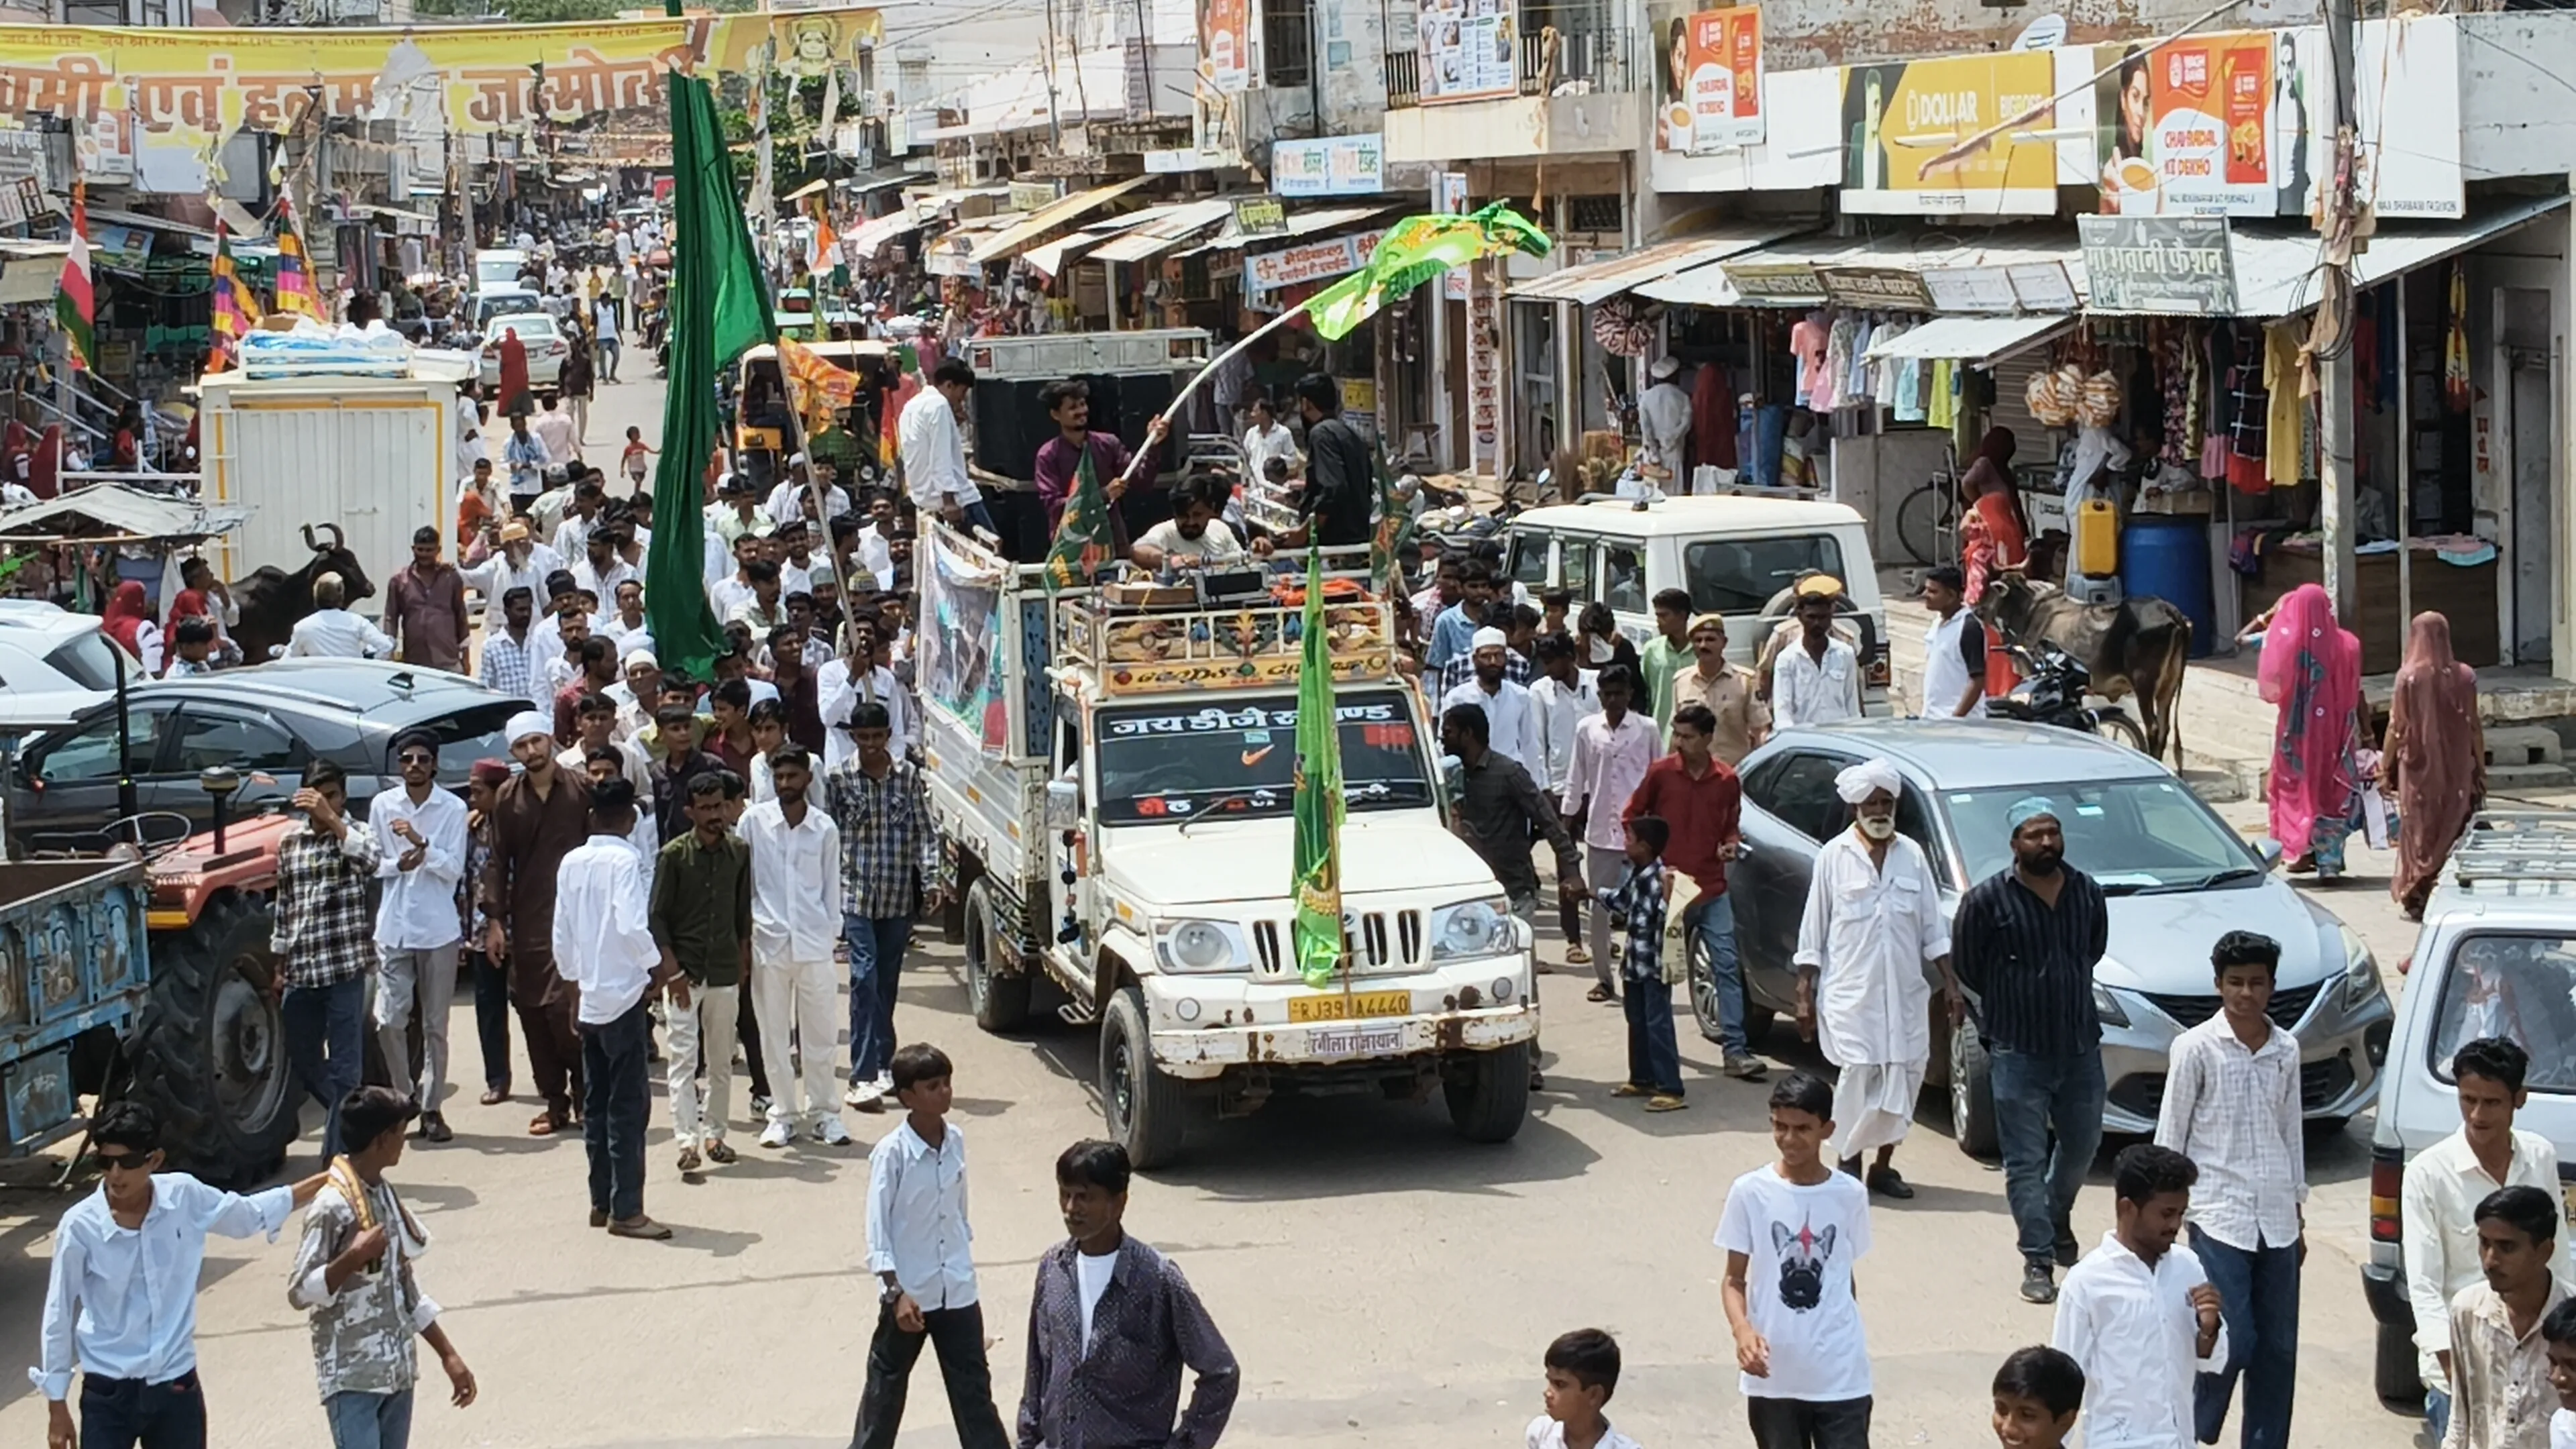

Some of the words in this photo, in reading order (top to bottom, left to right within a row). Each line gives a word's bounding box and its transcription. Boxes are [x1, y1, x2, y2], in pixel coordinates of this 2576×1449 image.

[1920, 91, 1978, 126] DOLLAR
[2110, 238, 2167, 274] भवानी
[2168, 236, 2224, 275] फैशन
[1110, 719, 1187, 735] जय
[1189, 706, 1270, 731] डीजे
